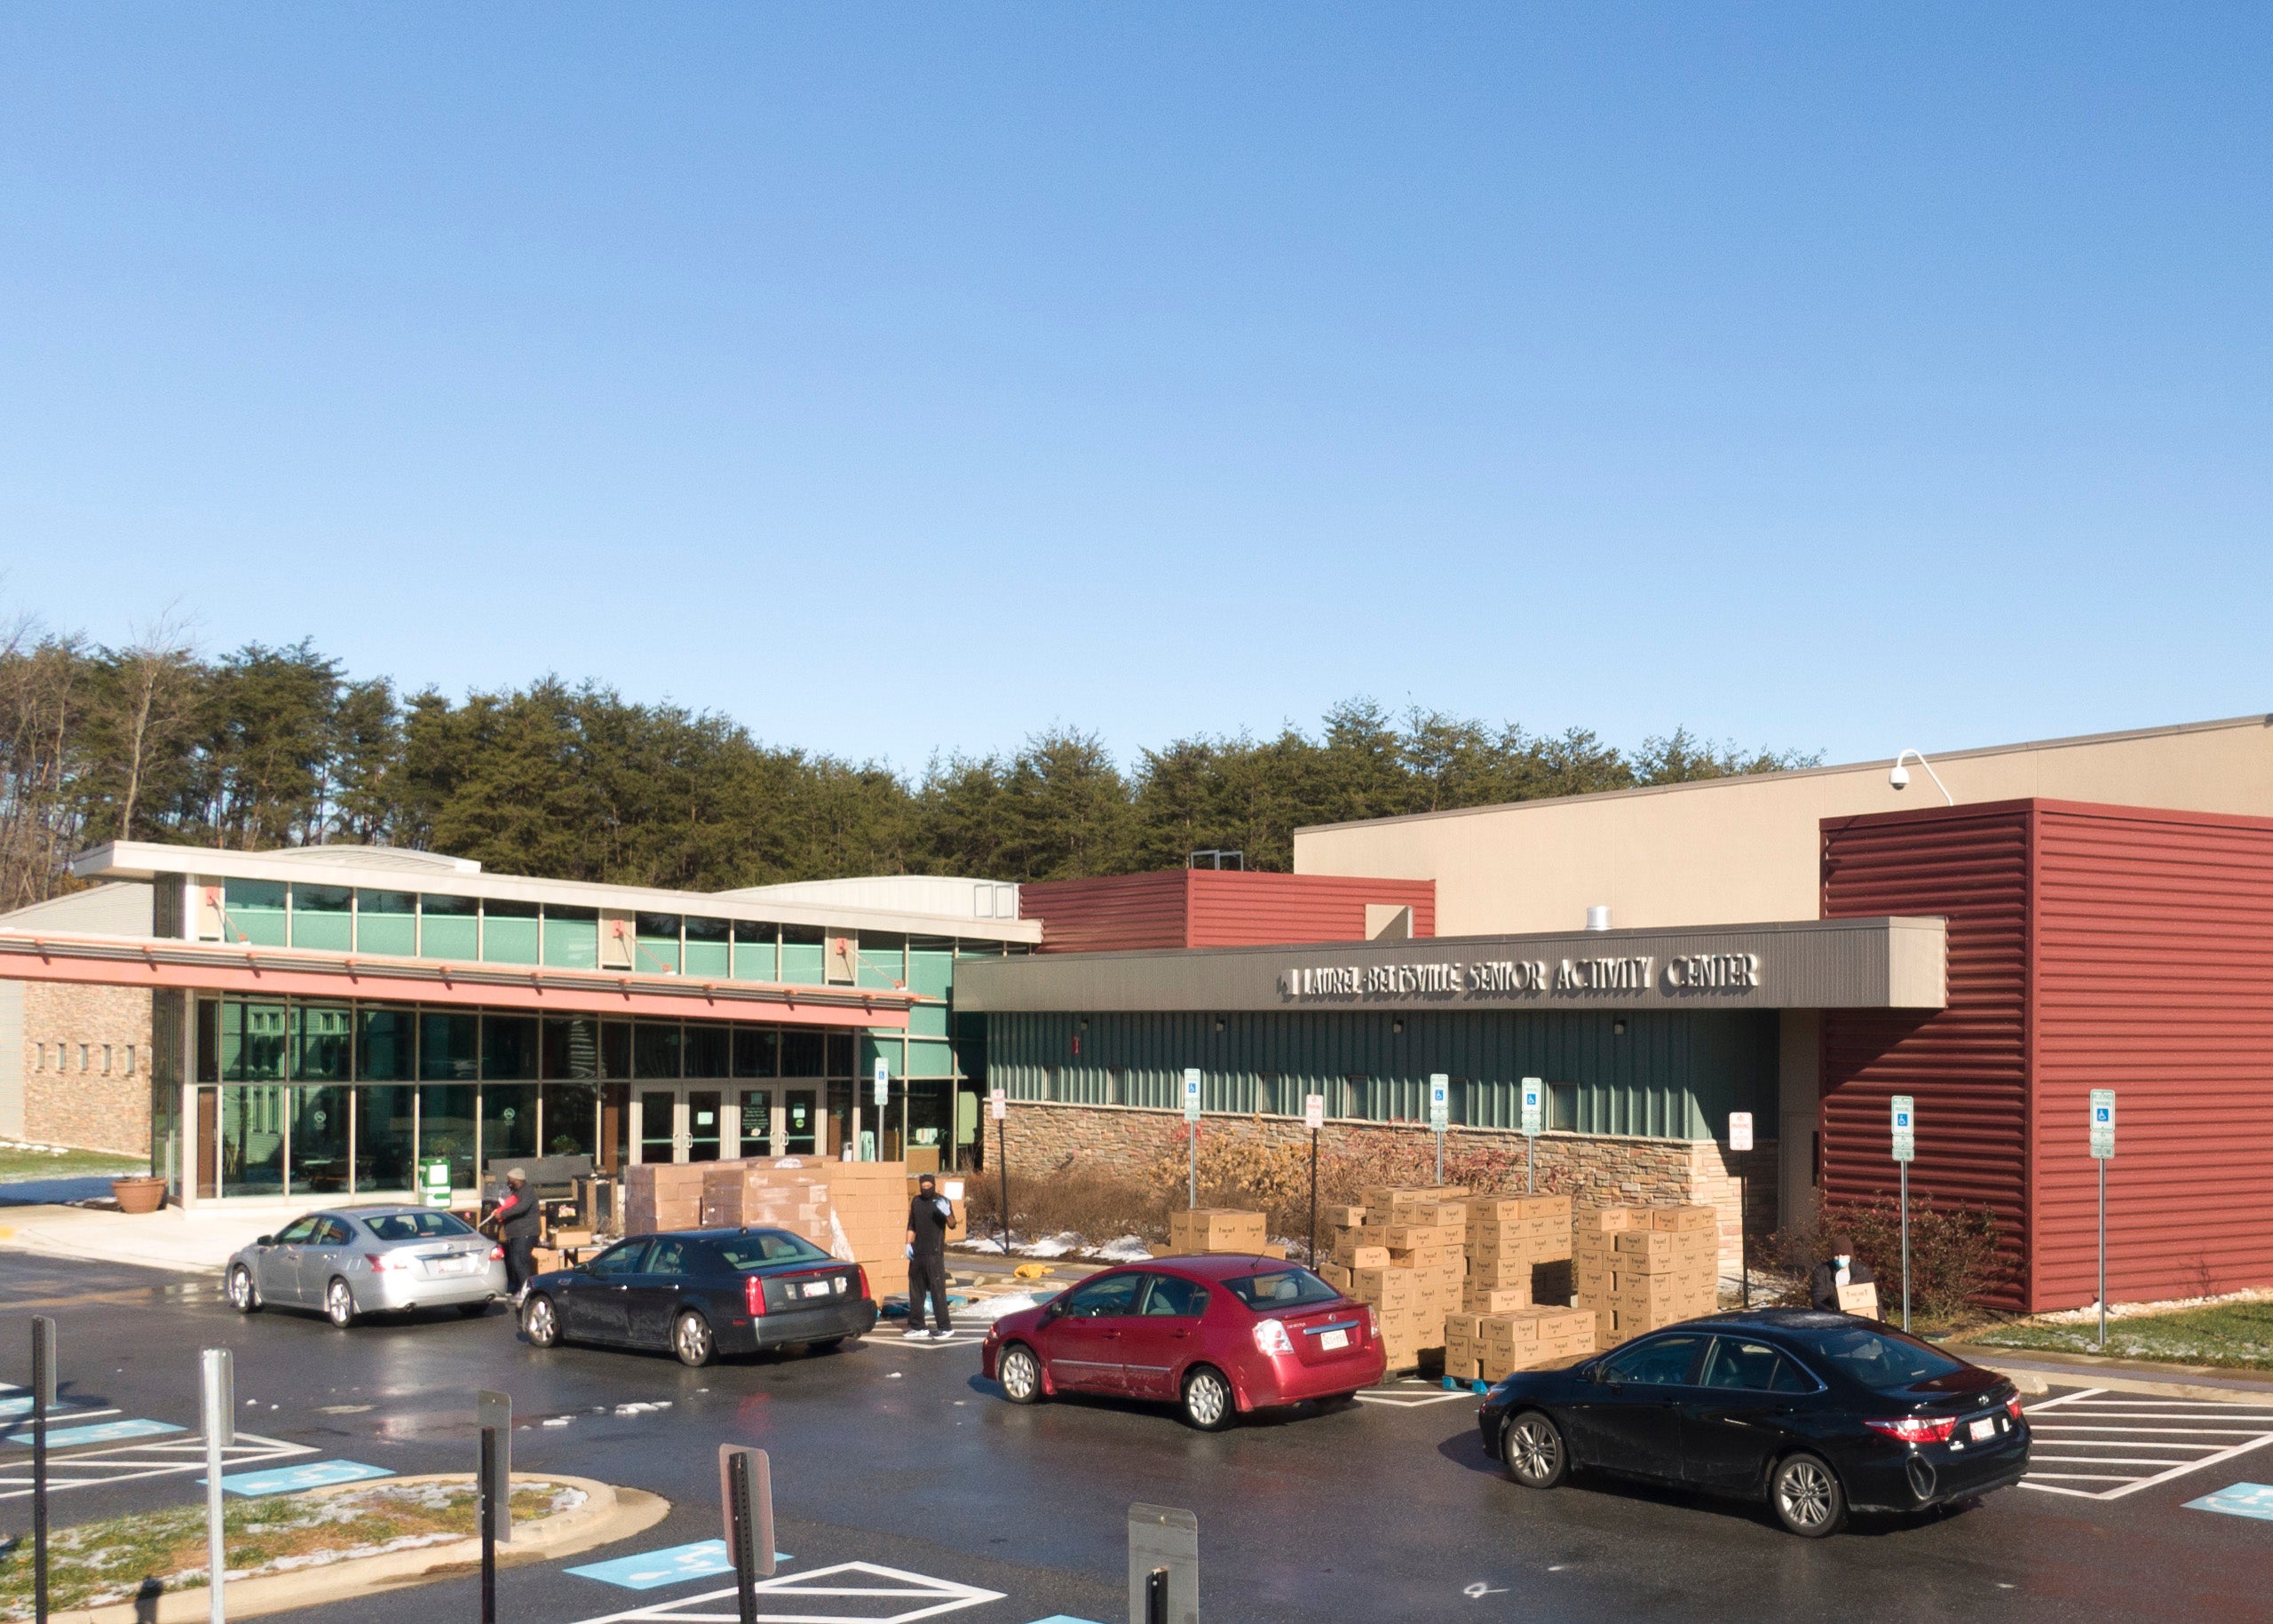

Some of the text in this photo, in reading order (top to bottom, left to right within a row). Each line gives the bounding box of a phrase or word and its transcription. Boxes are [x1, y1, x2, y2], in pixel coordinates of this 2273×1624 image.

[1468, 960, 1547, 992] SENIOR
[1556, 955, 1655, 990] ACTIVITY
[1667, 953, 1760, 988] CENTER
